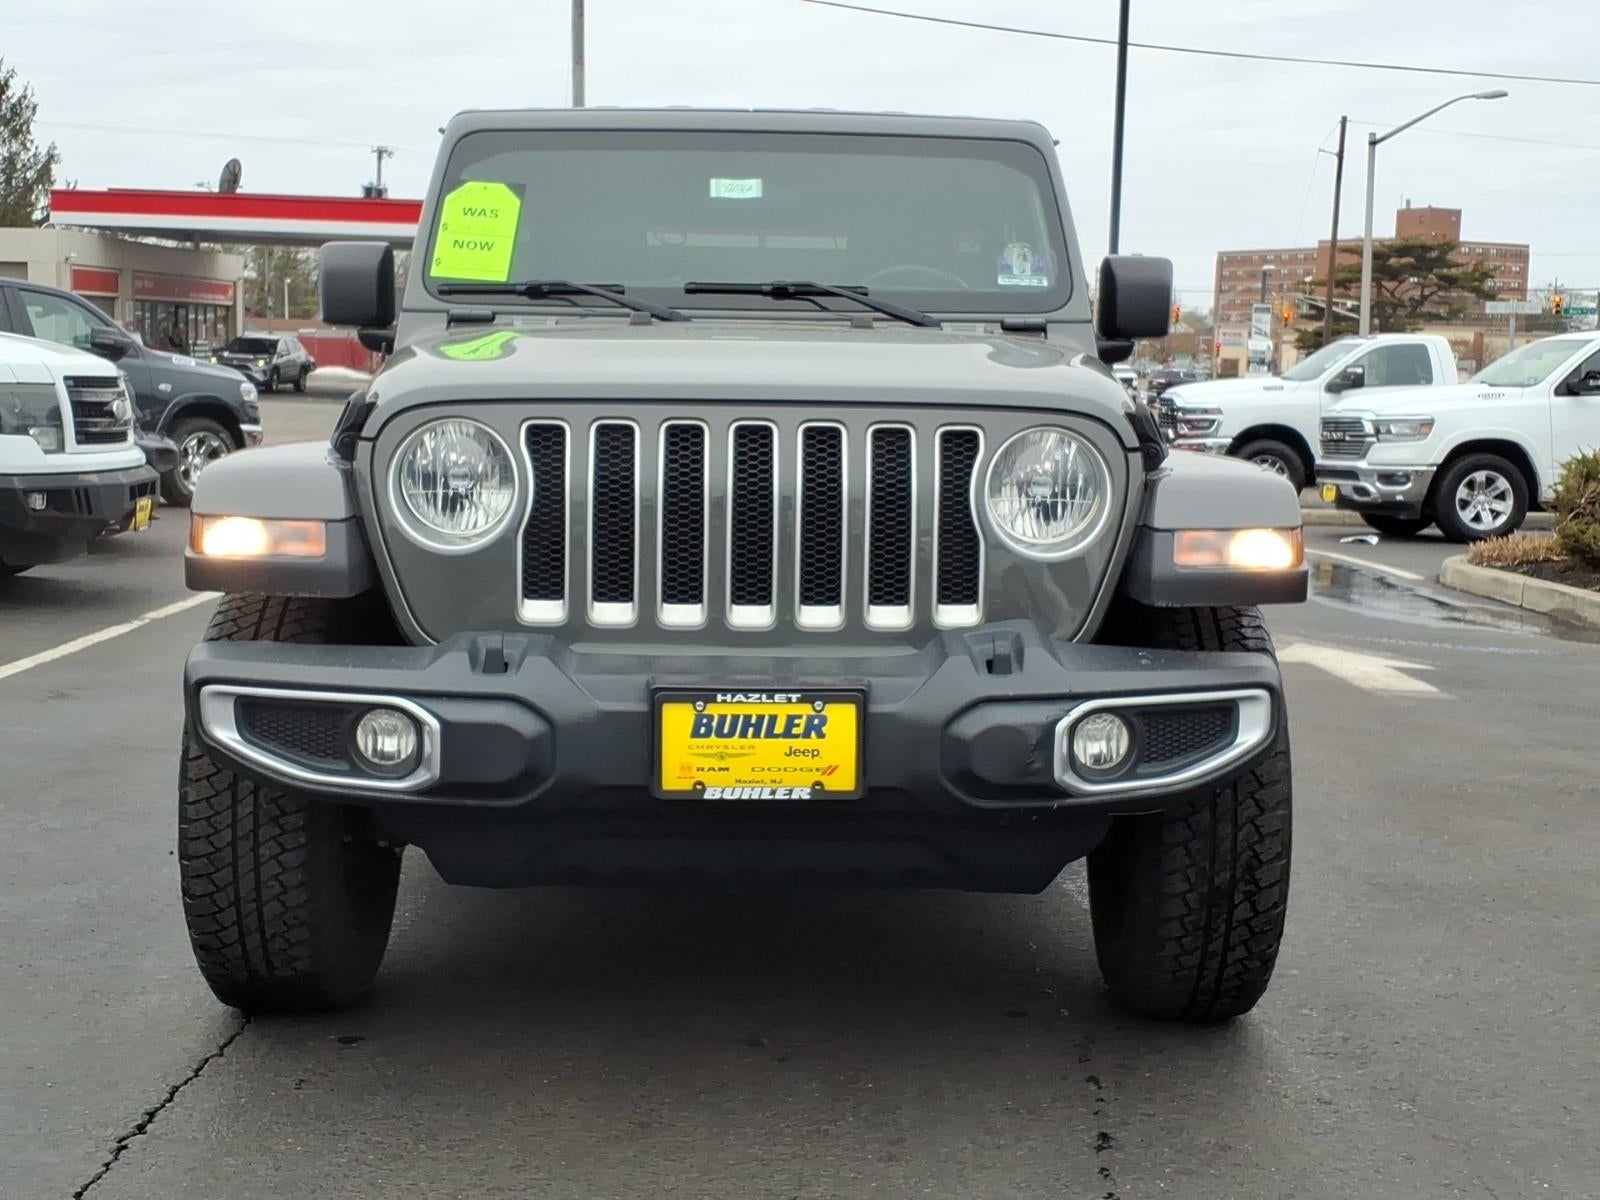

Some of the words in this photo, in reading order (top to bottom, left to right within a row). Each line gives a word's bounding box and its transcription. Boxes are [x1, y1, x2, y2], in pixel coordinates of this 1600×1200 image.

[463, 207, 498, 218] WAS
[442, 222, 448, 231] $
[453, 240, 494, 251] NOW
[435, 257, 441, 267] $
[716, 693, 802, 703] HAZLET
[690, 713, 828, 740] BUHLER
[784, 746, 820, 759] Jeep
[703, 787, 812, 800] BUHLER
